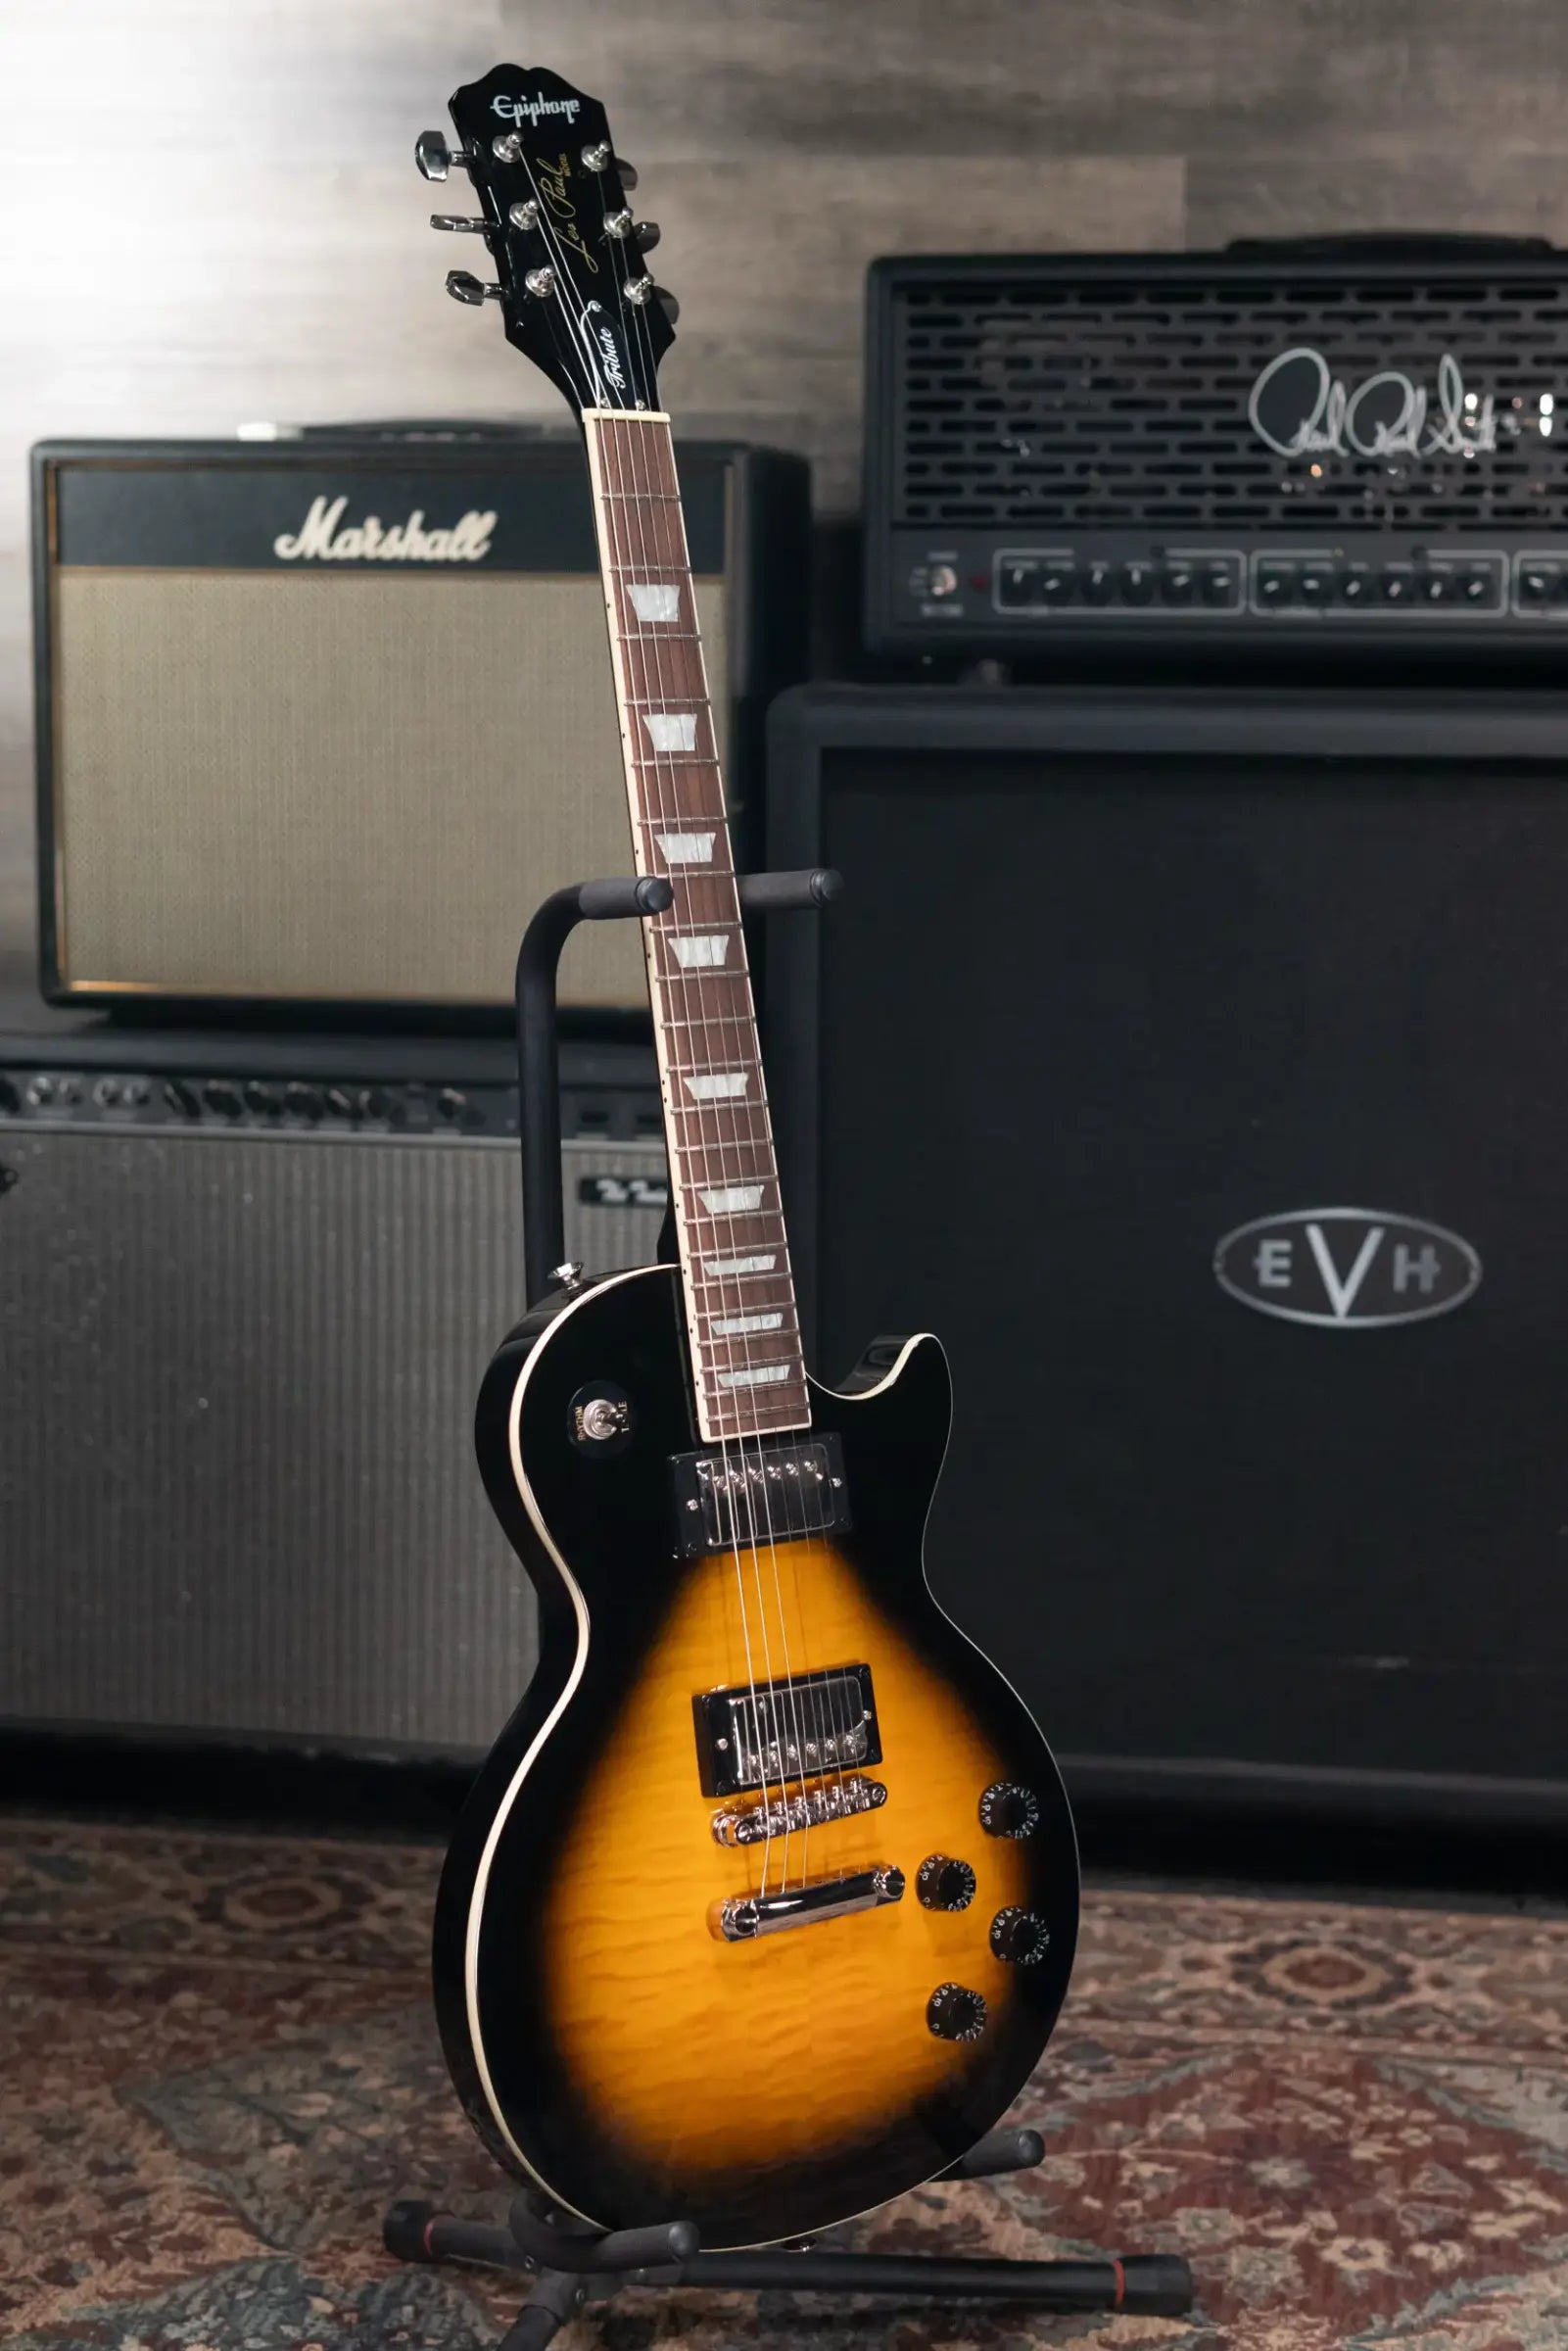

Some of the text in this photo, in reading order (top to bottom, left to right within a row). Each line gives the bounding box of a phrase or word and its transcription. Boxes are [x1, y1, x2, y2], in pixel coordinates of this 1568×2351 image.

[490, 91, 581, 128] Epiphone
[536, 158, 599, 273] Les Paul
[599, 326, 627, 389] Tribute
[273, 495, 499, 562] Marshall
[1252, 1223, 1442, 1319] EVH
